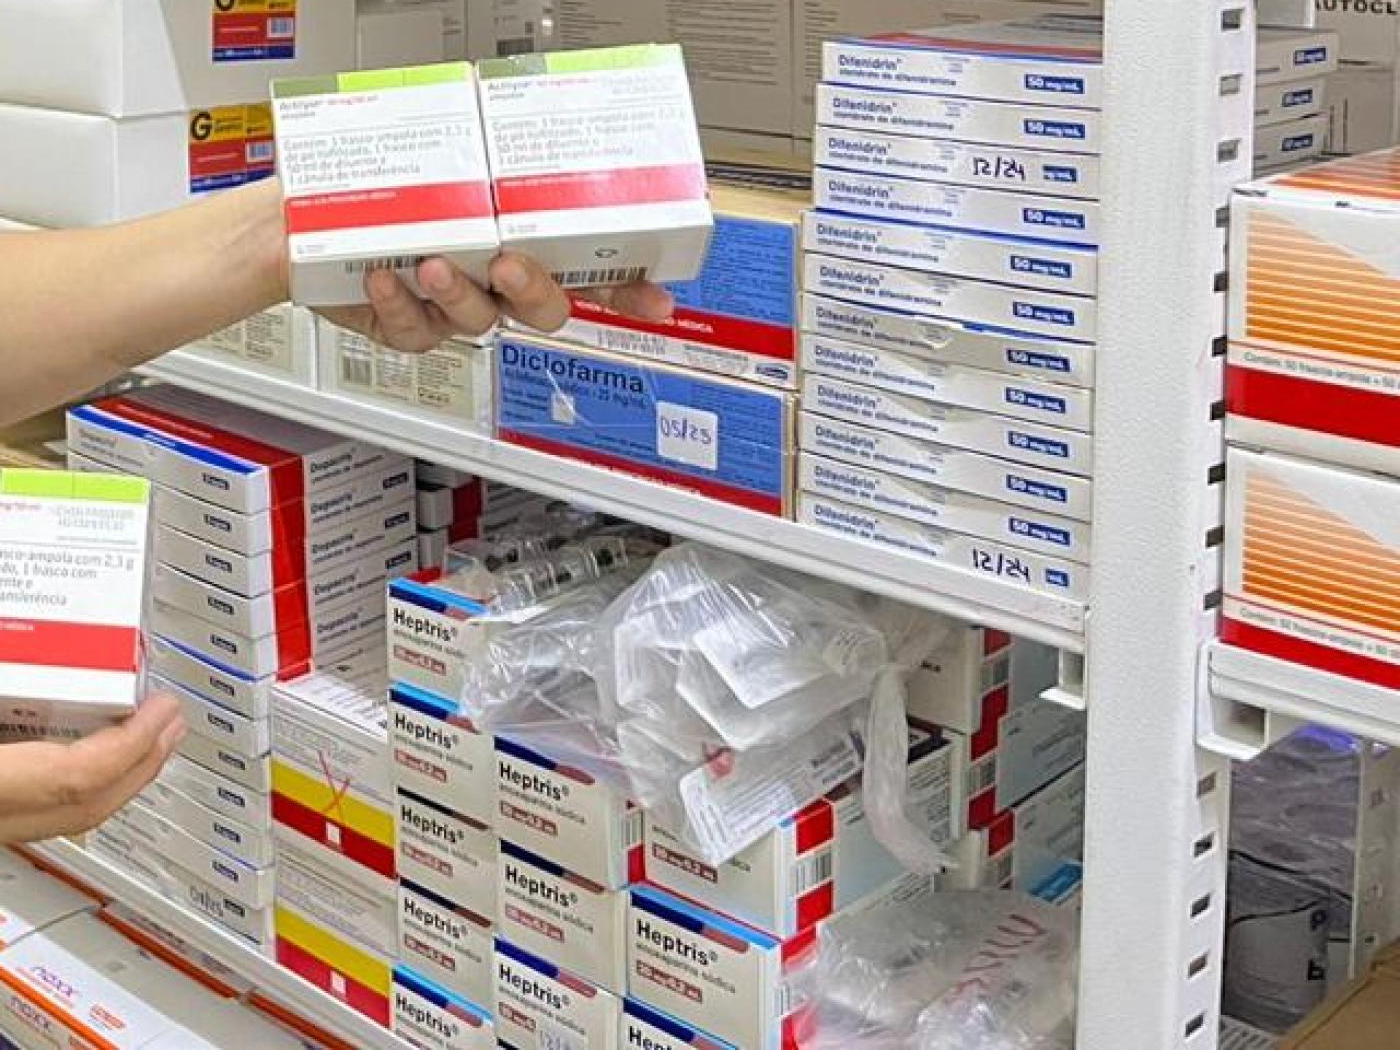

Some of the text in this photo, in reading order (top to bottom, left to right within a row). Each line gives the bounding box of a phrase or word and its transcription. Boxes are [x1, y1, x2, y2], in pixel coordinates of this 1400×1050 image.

[190, 110, 214, 142] G
[972, 156, 1026, 182] 12/24
[502, 345, 645, 393] Diclofarma
[71, 567, 98, 579] com
[74, 554, 101, 566] com
[972, 548, 1031, 582] 12/24
[23, 579, 34, 591] e
